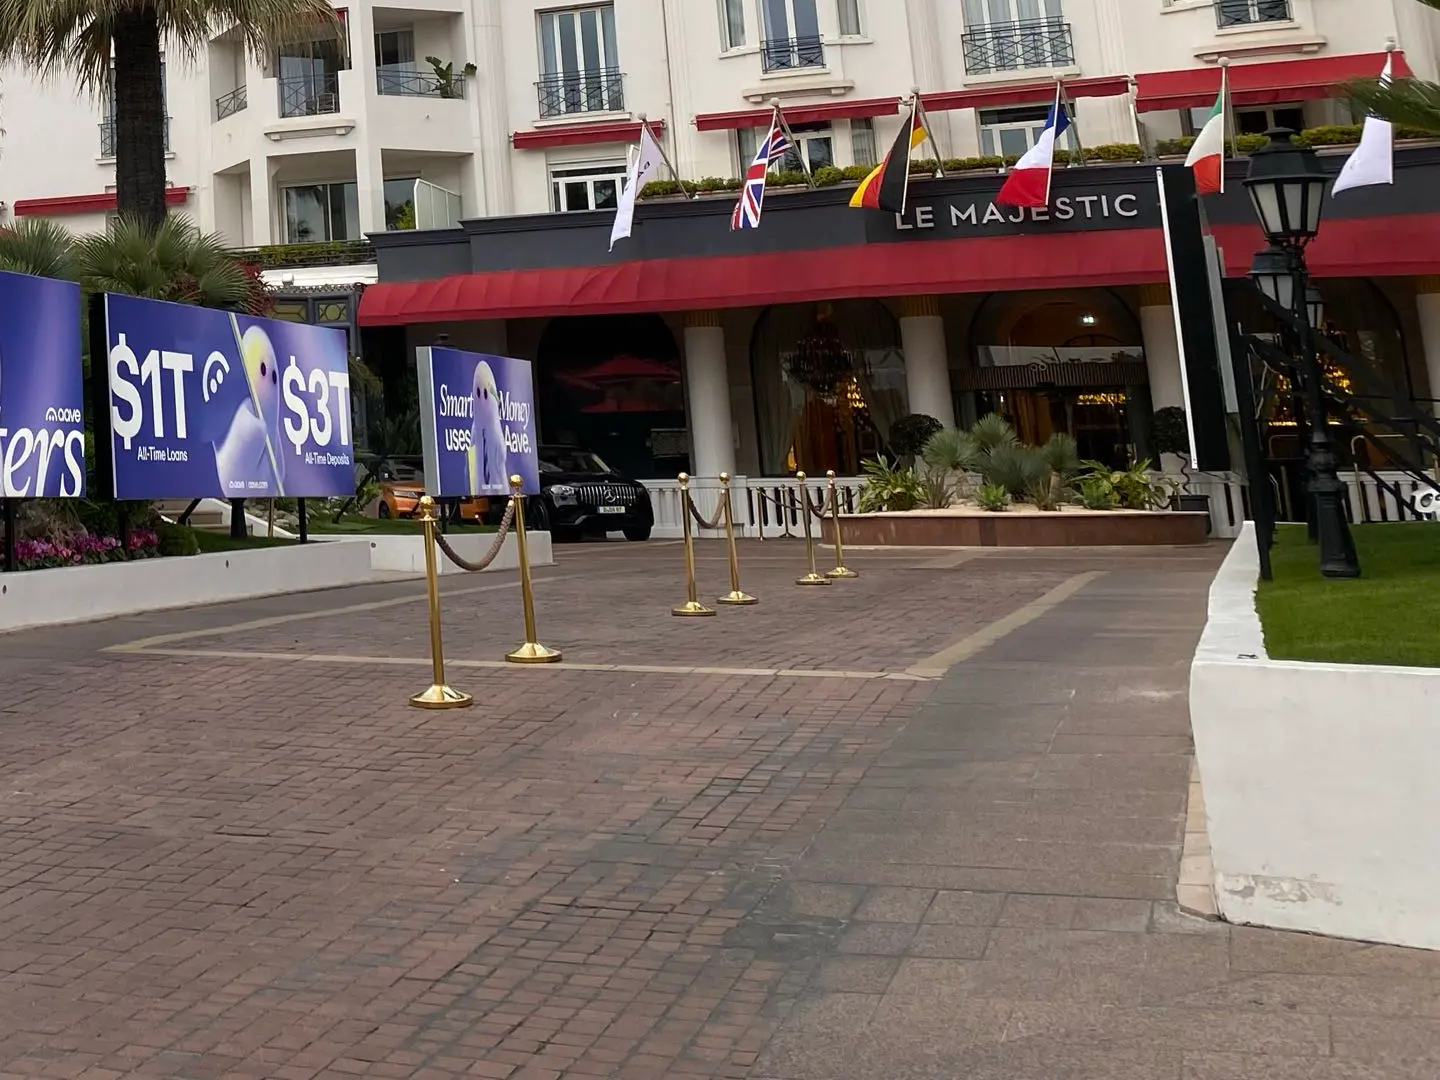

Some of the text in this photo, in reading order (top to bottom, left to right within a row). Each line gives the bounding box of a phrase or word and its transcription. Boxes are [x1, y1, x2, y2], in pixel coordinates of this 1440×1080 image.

[896, 194, 1138, 230] LE MAJESTIC
[110, 333, 194, 450] $1T
[282, 355, 350, 455] $3T
[440, 383, 531, 431] Smart Money
[58, 408, 81, 423] aave
[137, 446, 188, 462] All-Time Loans
[445, 425, 532, 453] uses Aave.
[305, 452, 350, 467] All-Time Deposits
